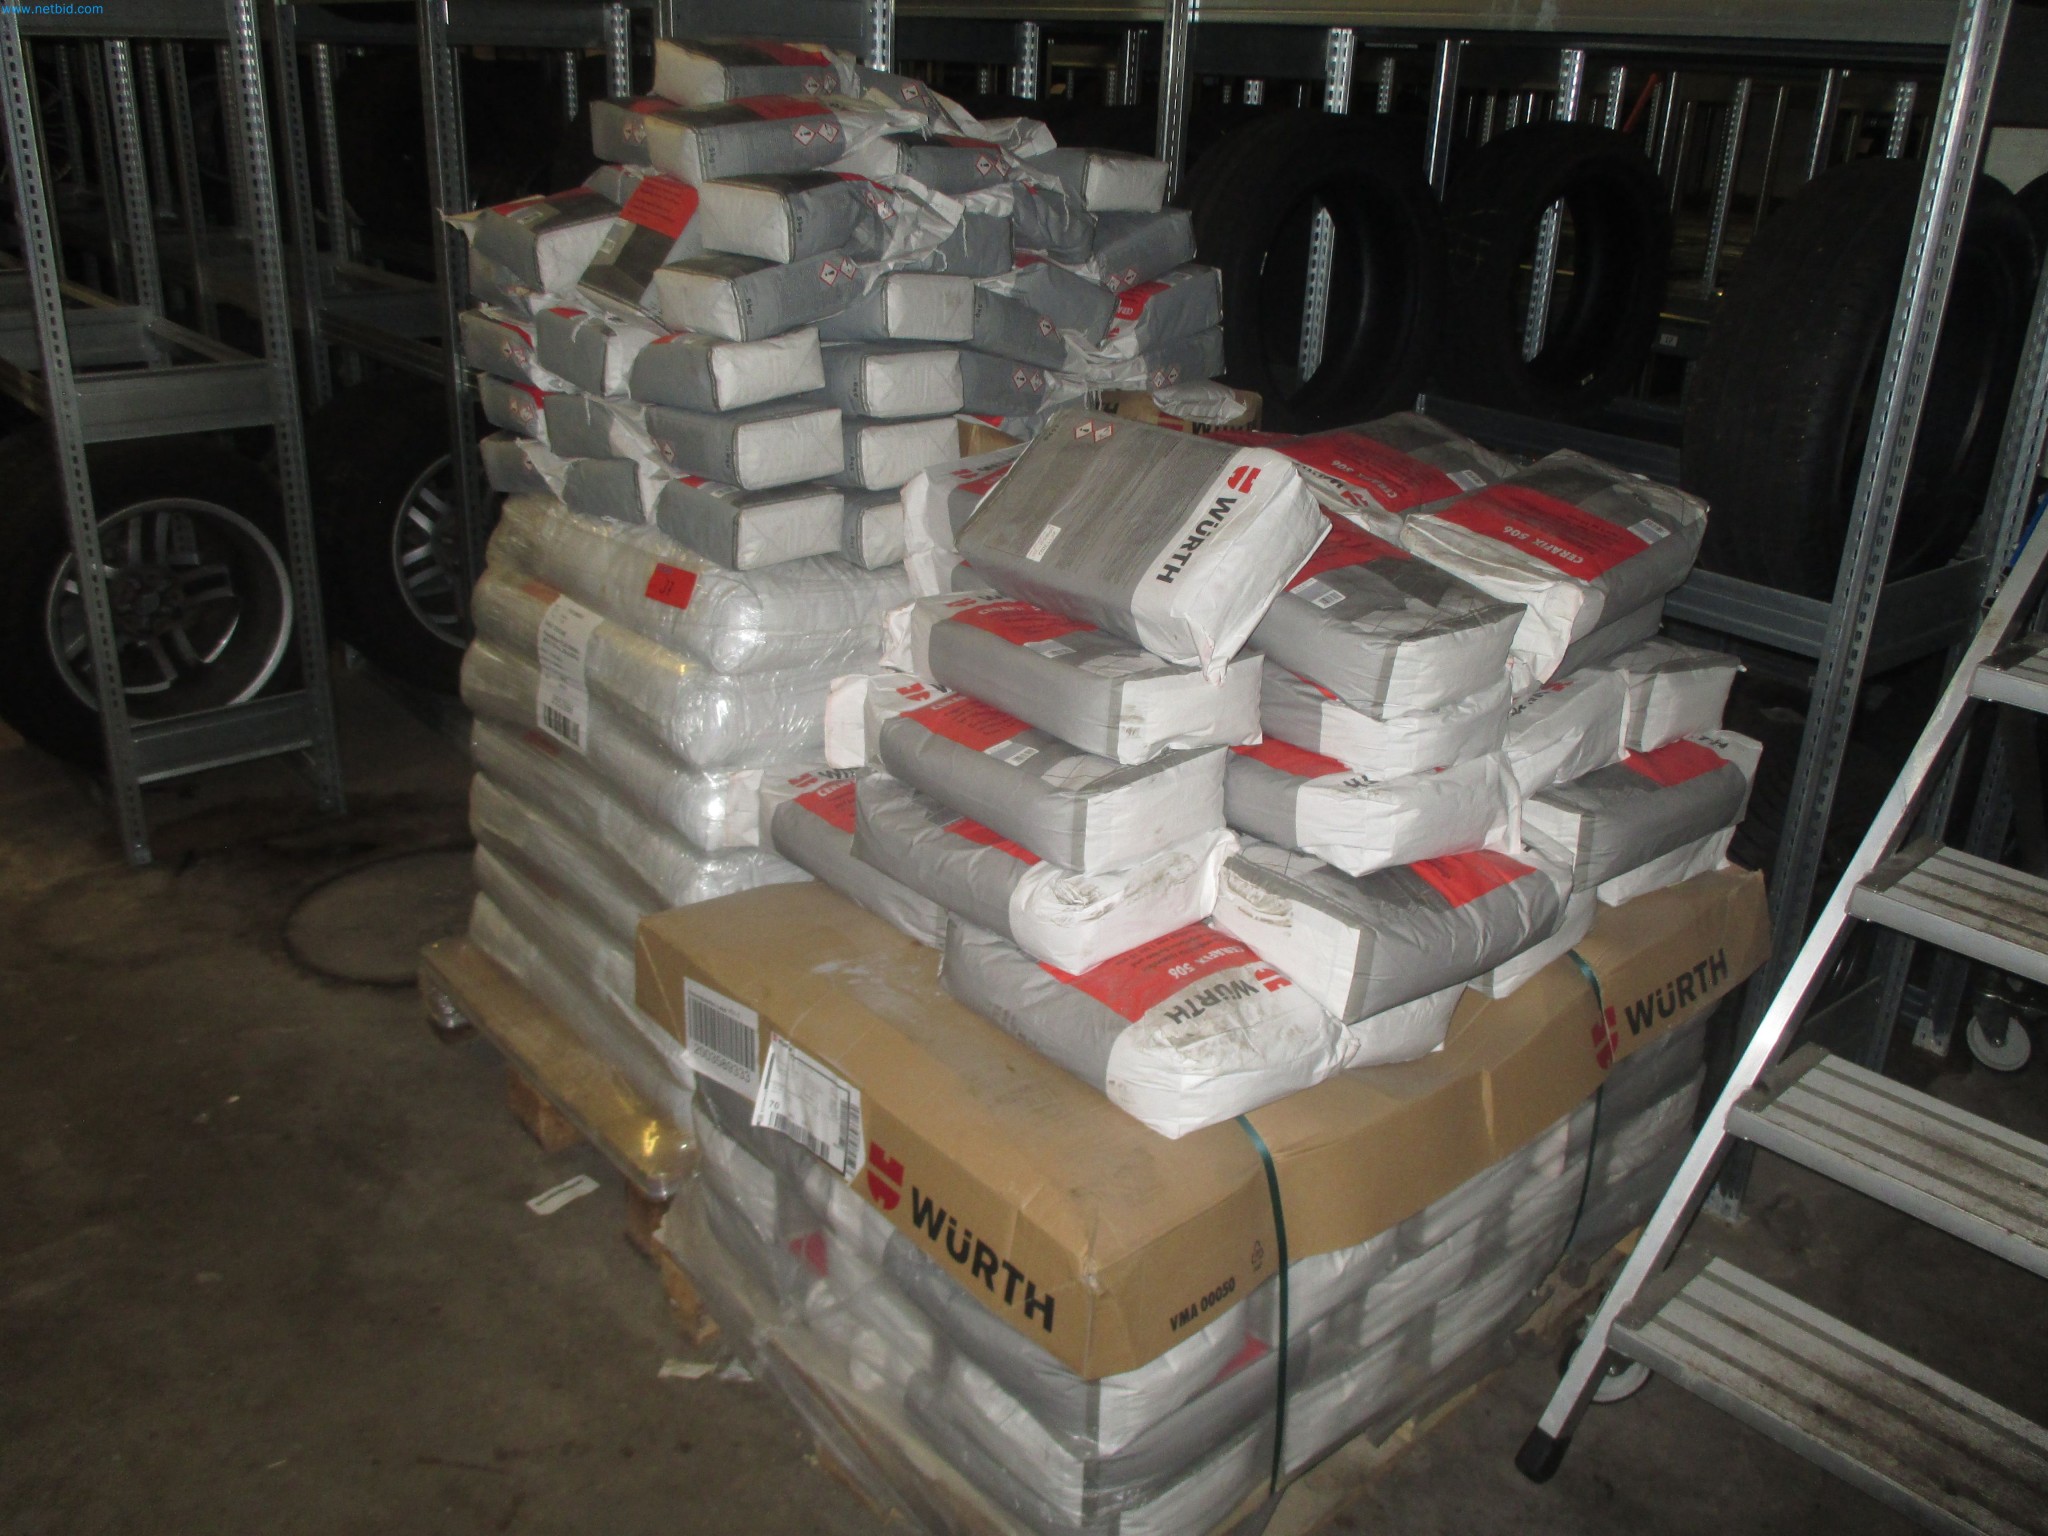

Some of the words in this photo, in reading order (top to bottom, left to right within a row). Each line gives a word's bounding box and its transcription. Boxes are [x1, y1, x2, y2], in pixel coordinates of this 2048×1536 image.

[1331, 460, 1355, 473] 506
[1156, 497, 1238, 584] WÜRTH
[1503, 526, 1530, 540] 506
[1532, 538, 1585, 564] CERAFIX
[1167, 962, 1196, 979] 506
[1624, 949, 1729, 1036] WÜRTH
[1163, 979, 1260, 1025] WÜRTH
[911, 1186, 1056, 1334] WÜRTH
[1170, 1303, 1199, 1331] VMA
[1201, 1276, 1236, 1312] 00050
